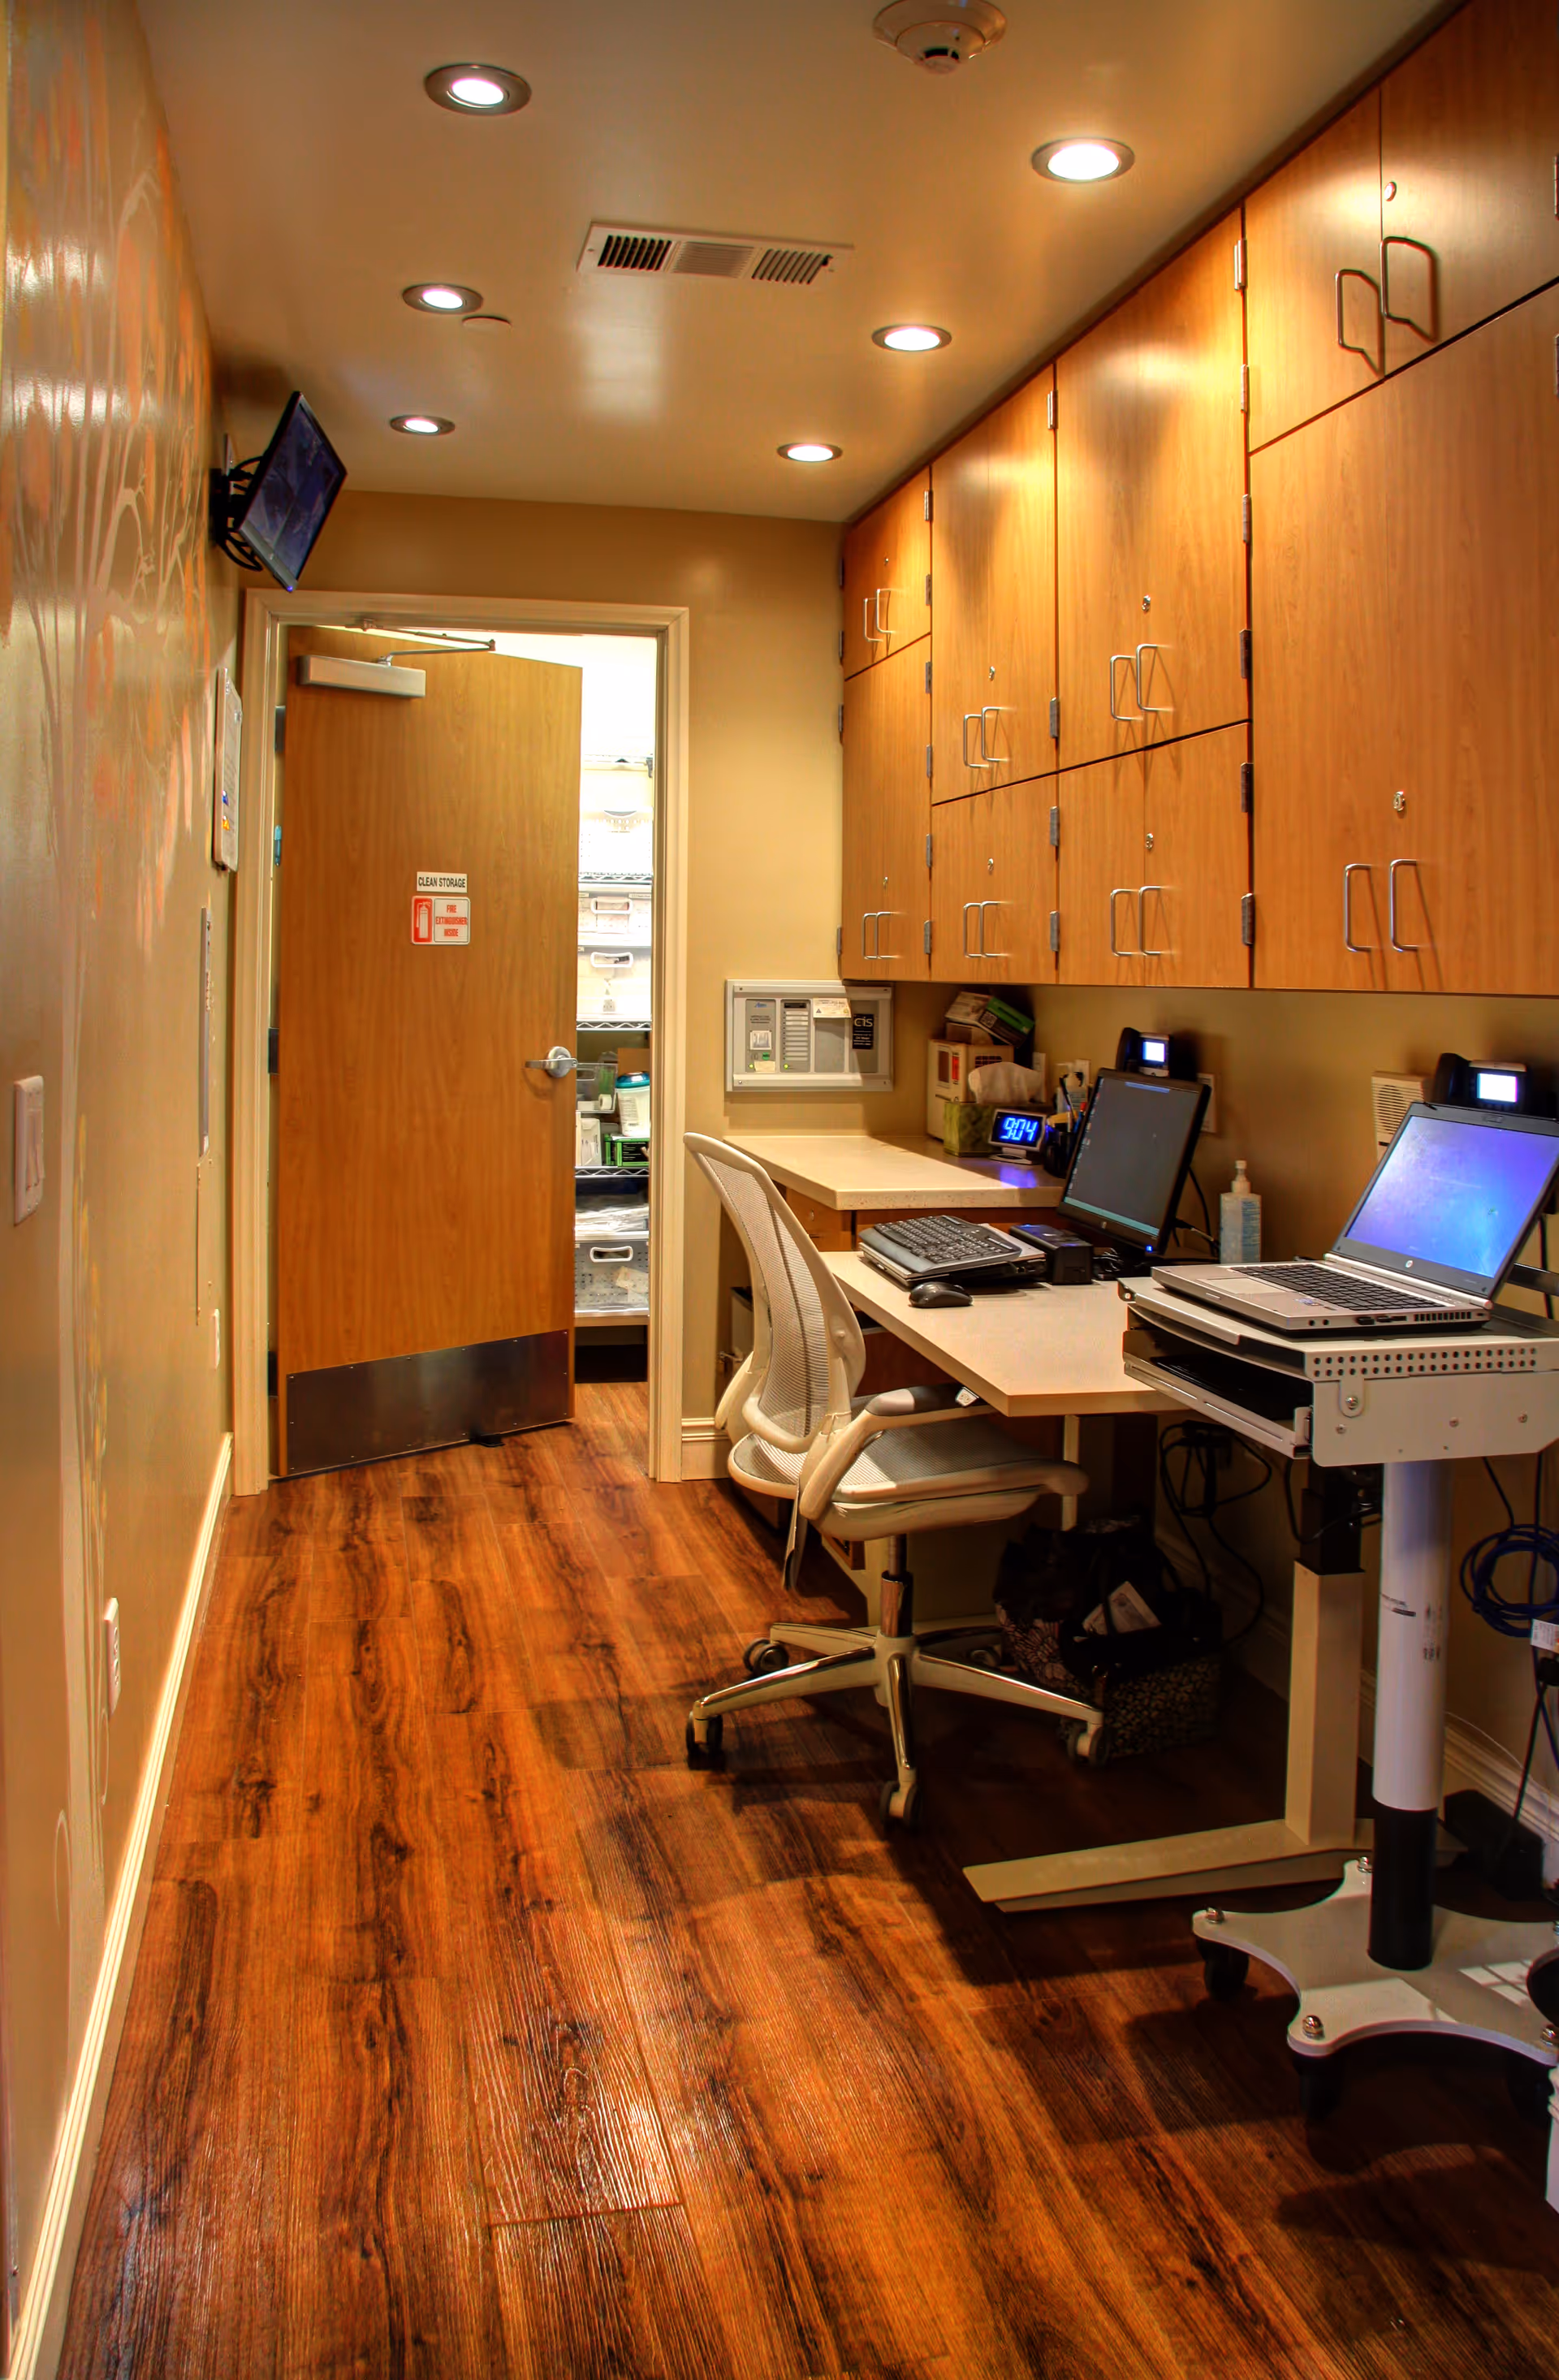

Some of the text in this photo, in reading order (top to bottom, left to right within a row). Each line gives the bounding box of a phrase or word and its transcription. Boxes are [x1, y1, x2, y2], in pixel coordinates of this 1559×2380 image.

[418, 877, 465, 888] CLEAN STORAGE
[446, 905, 457, 913] FIRE
[436, 917, 468, 925] EXTSHER
[1000, 1117, 1039, 1142] 9:04
